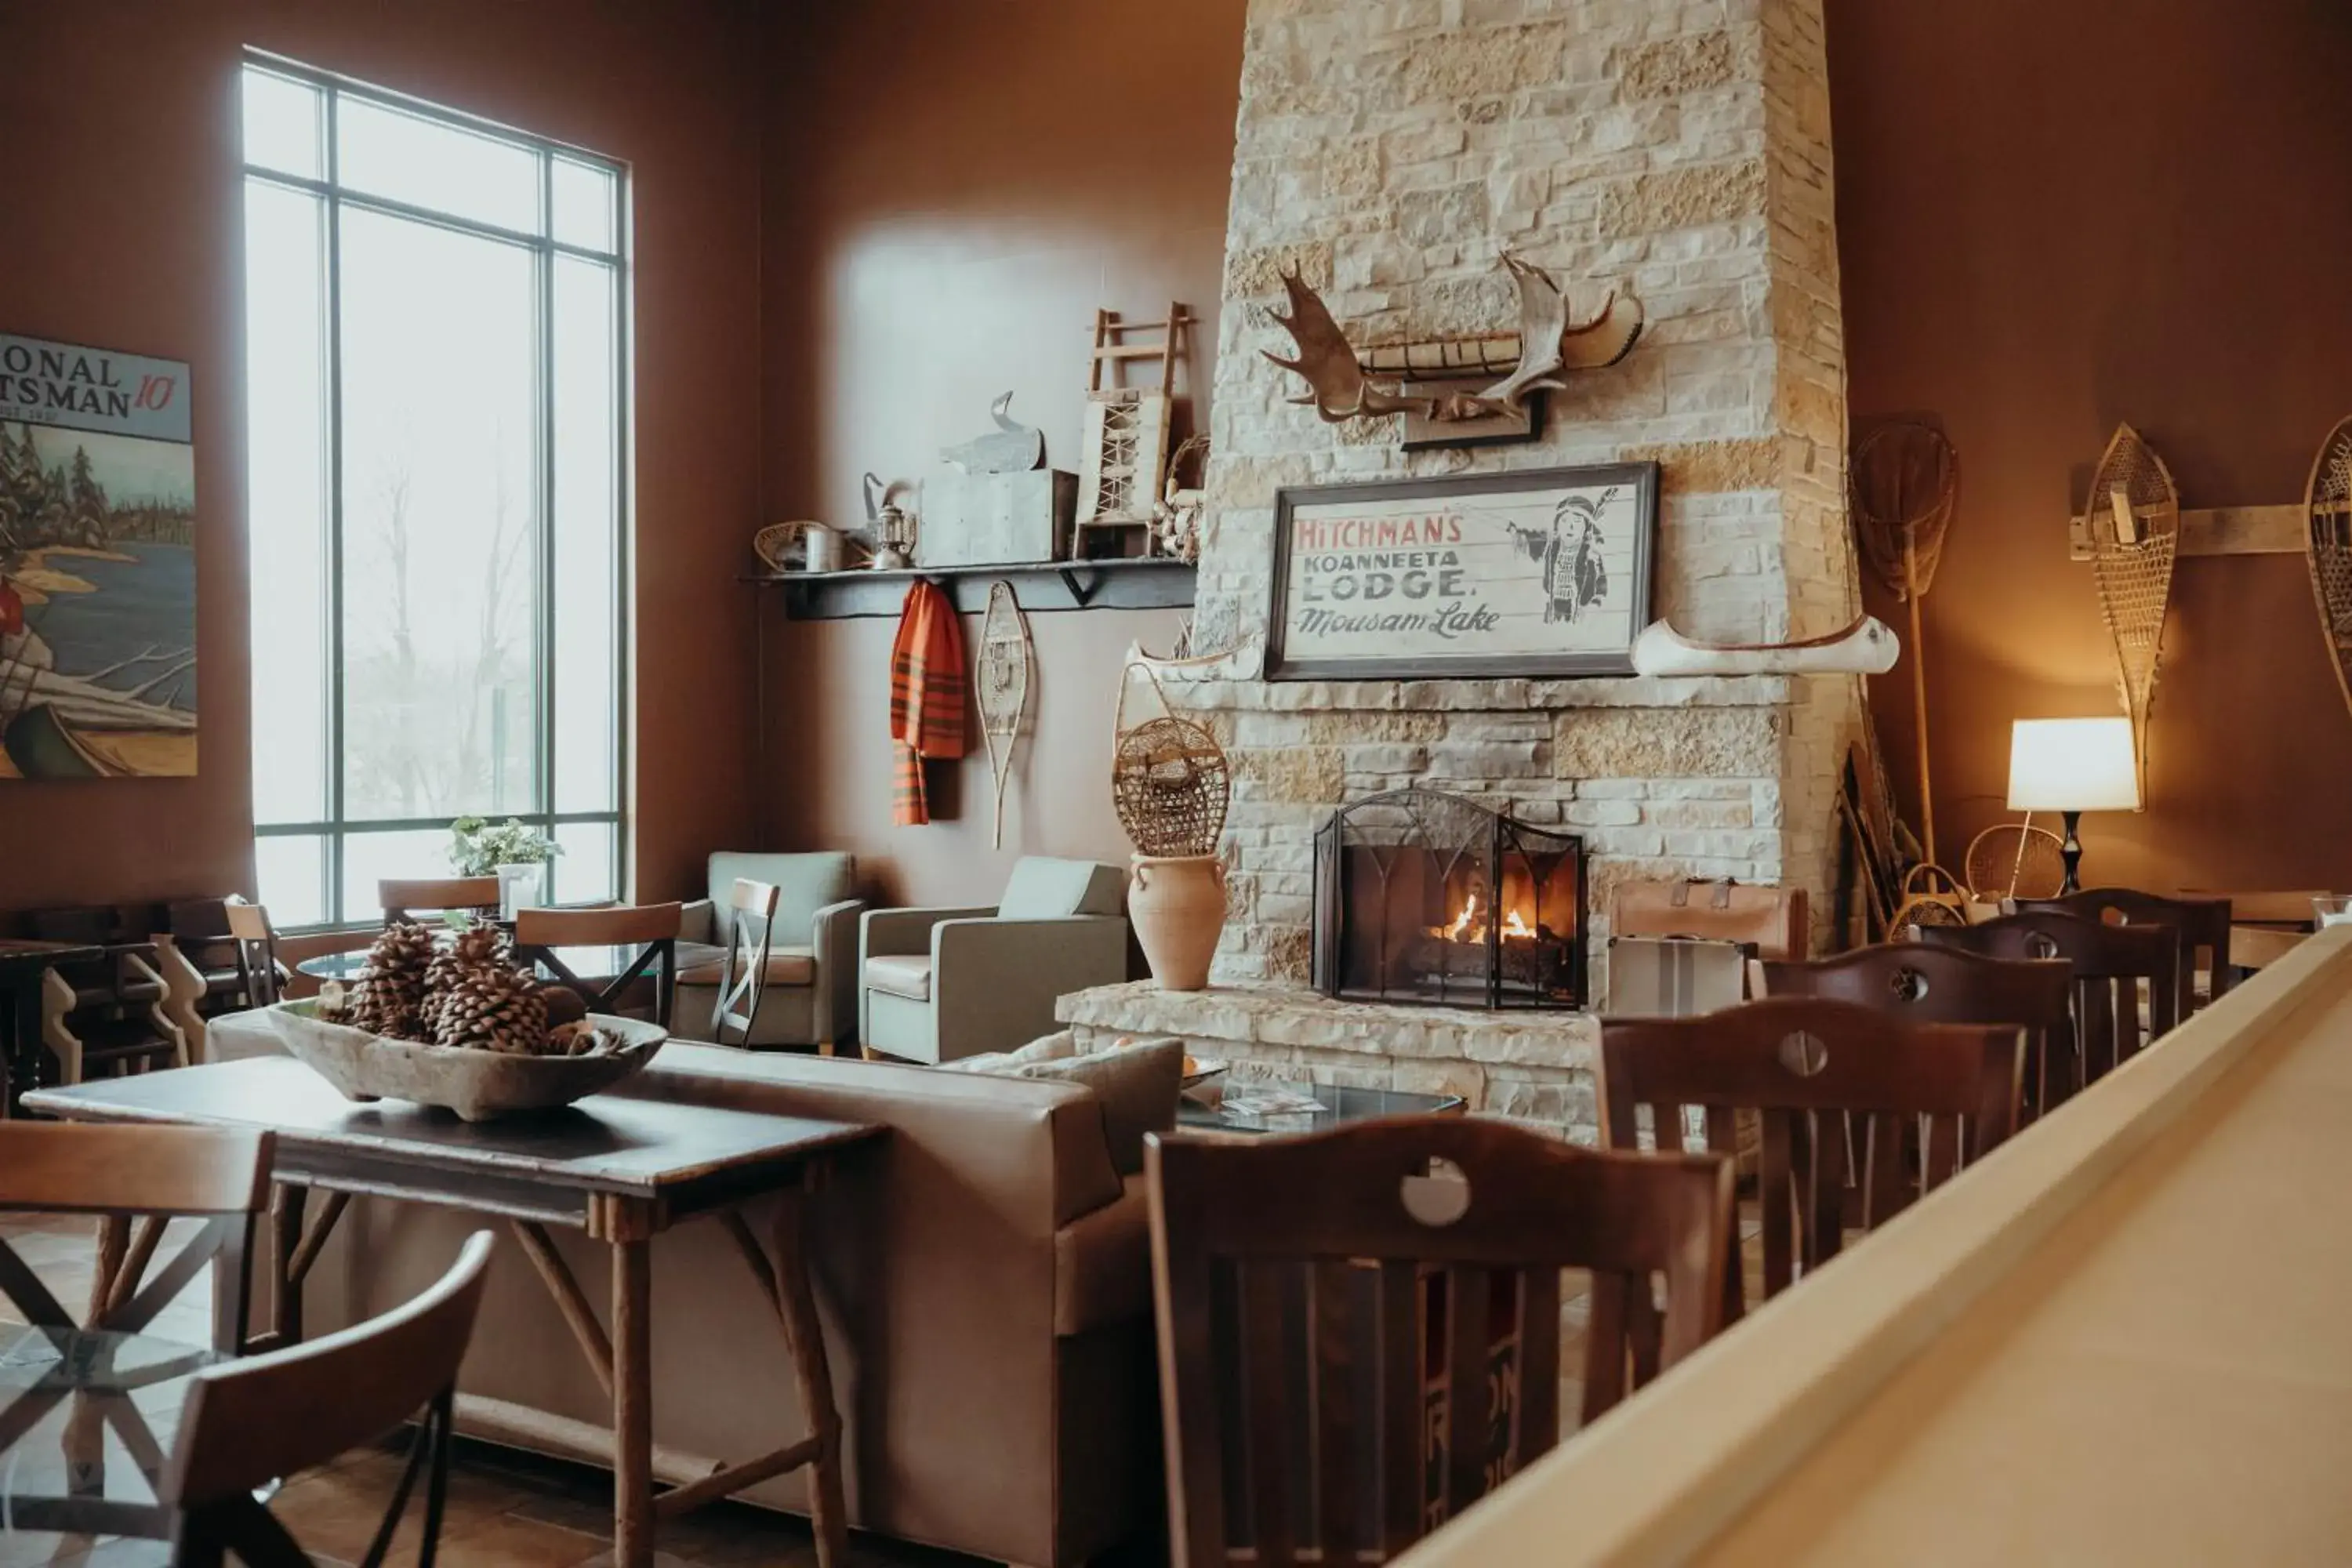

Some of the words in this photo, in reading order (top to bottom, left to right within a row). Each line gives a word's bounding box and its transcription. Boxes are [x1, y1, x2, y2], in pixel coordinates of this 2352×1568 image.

[1304, 550, 1459, 573] KOANNEETA
[1298, 607, 1428, 638] Mousam
[1428, 601, 1502, 640] Lake
